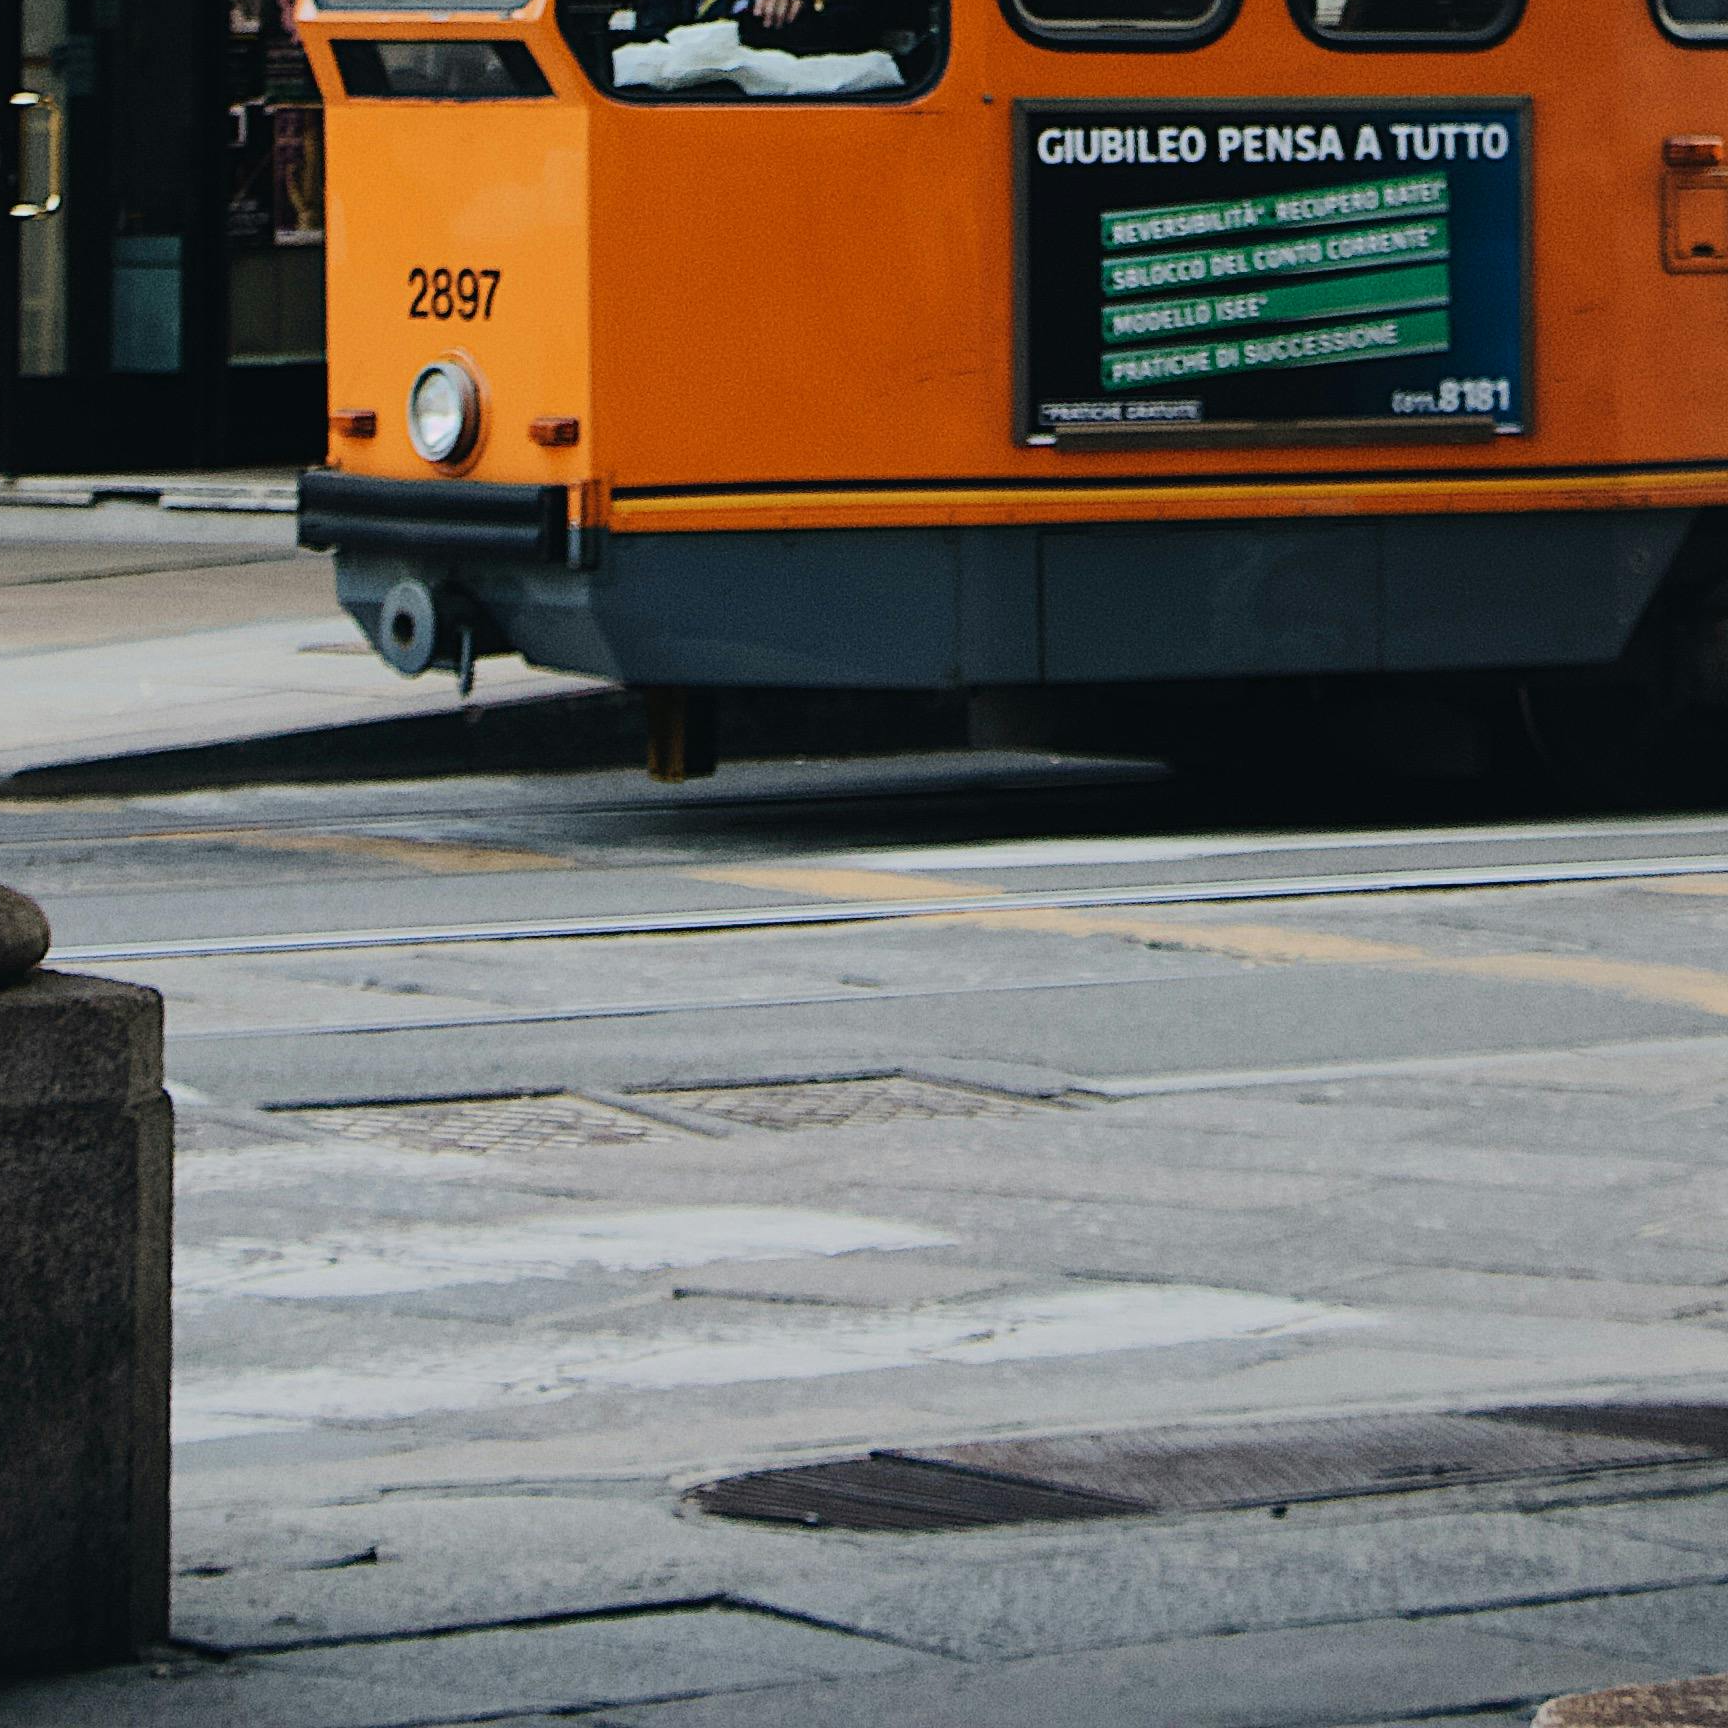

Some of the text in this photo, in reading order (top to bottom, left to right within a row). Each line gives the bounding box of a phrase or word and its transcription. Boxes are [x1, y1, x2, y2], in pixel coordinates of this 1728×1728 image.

[1037, 123, 1509, 164] GIUBILEO PENSA A TUTTO
[1276, 189, 1379, 221] RECUPERO
[1112, 258, 1206, 289] SBLOCCO
[1210, 253, 1252, 276] DEL
[1252, 243, 1322, 270] CONTO
[407, 267, 502, 320] 2897
[1112, 304, 1211, 336] MODELLO
[1112, 323, 1398, 382] PRATICHE DI SUCCESSIONE
